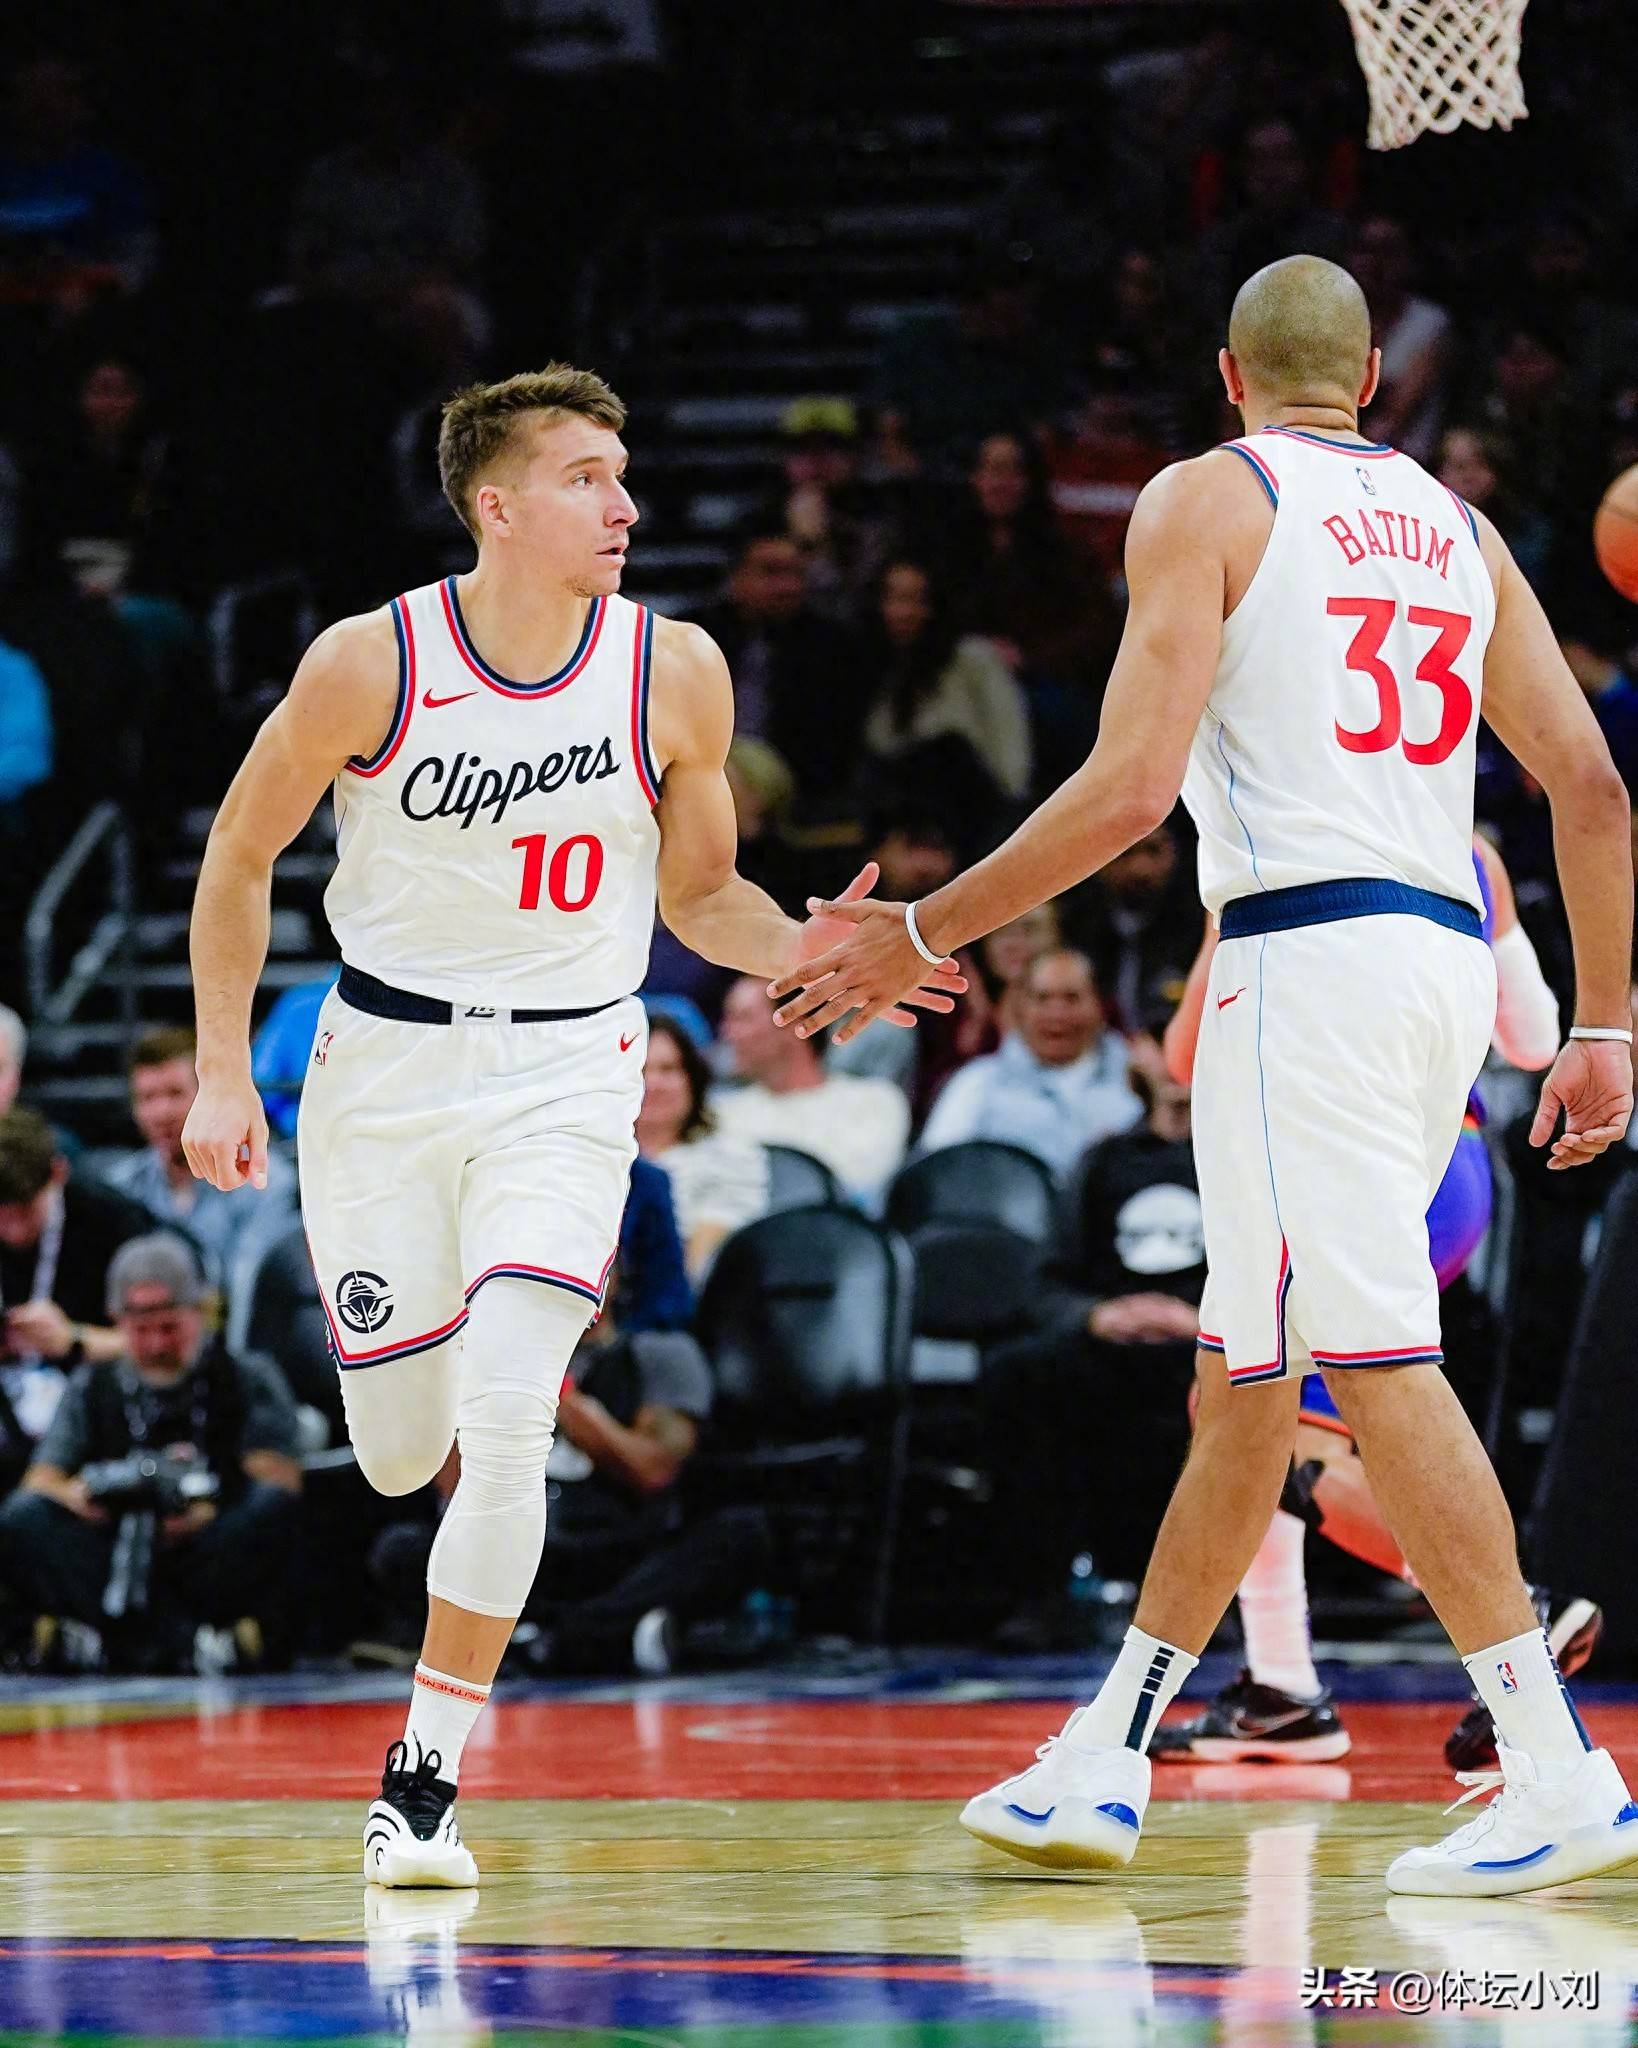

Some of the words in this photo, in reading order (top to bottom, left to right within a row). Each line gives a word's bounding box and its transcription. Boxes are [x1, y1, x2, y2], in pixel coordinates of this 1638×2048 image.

[1323, 509, 1454, 580] BATUM
[1327, 596, 1472, 765] 33
[401, 736, 621, 829] Clippers
[511, 834, 604, 912] 10
